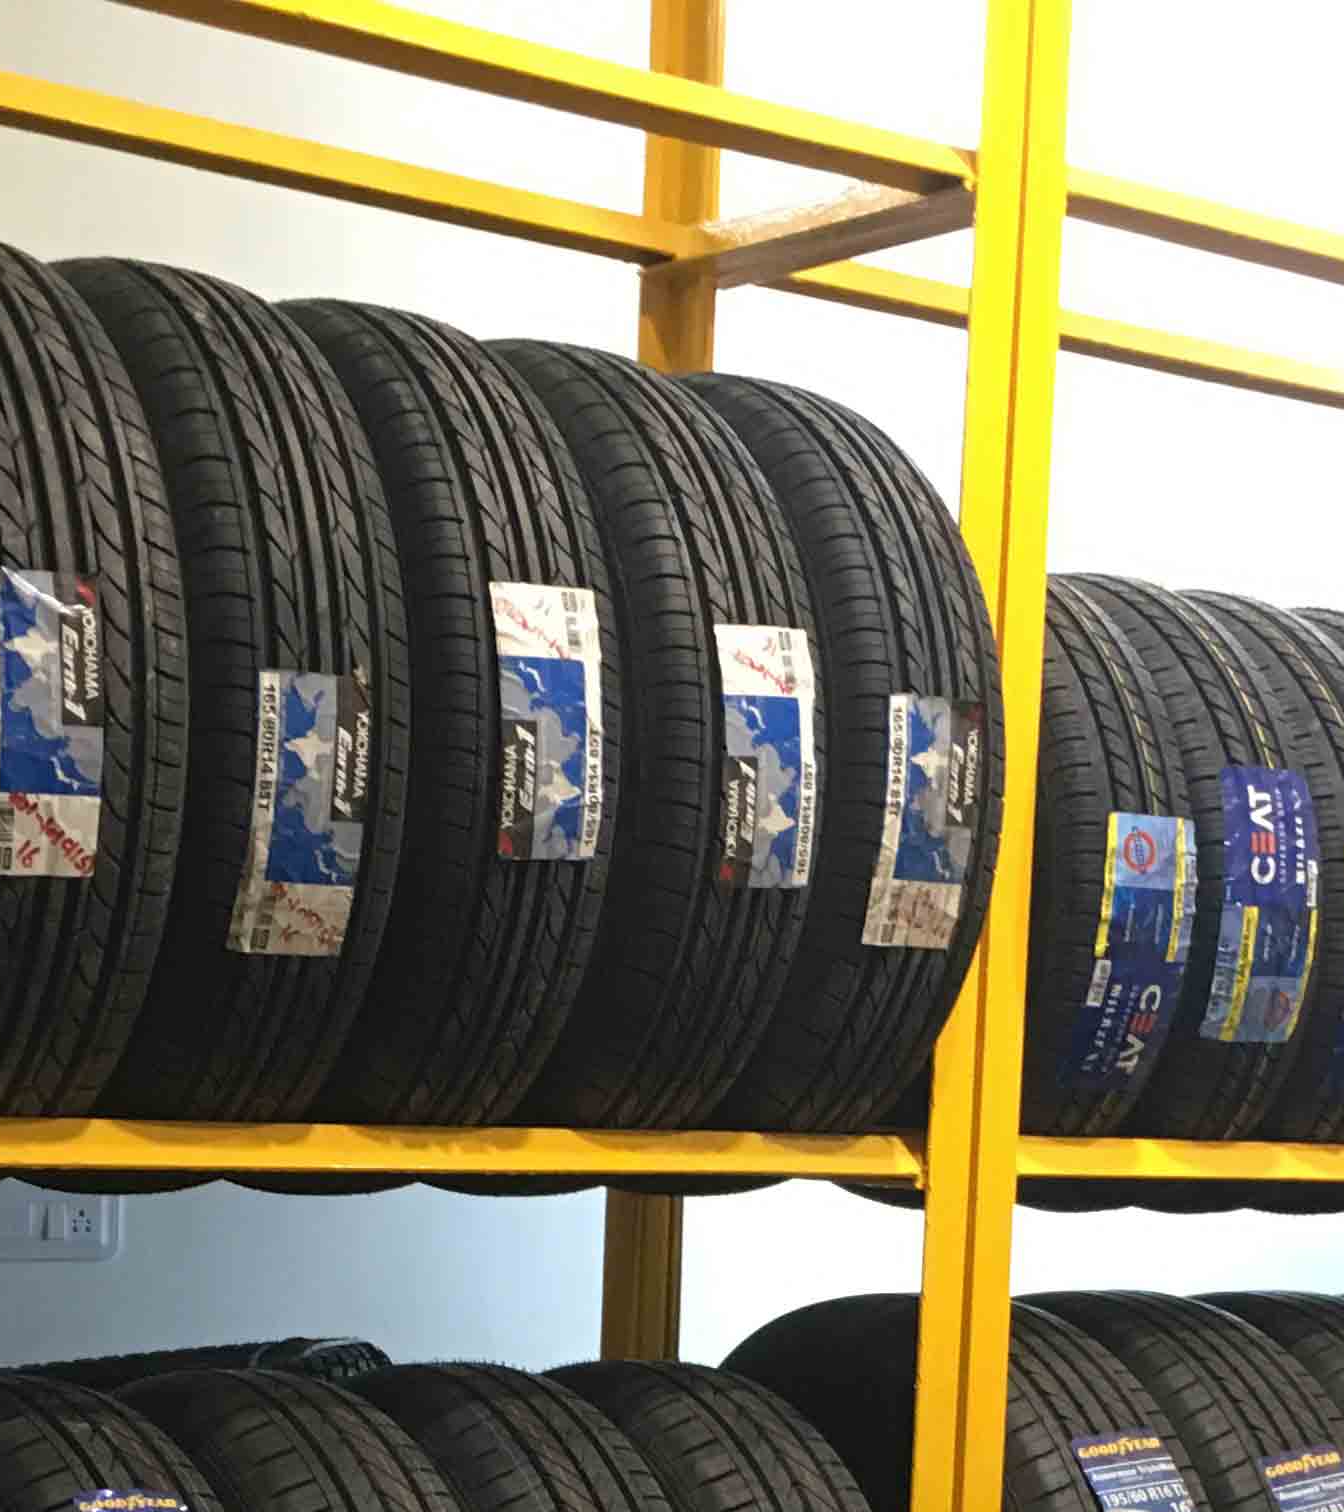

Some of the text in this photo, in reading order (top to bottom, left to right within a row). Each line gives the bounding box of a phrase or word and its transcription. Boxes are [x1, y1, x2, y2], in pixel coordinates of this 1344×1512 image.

[76, 604, 98, 700] YOKOHAMA
[352, 711, 369, 799] YOKOHAMA
[500, 745, 517, 829] YOKOHAMA
[726, 779, 739, 857] YOKOHAMA
[1247, 785, 1276, 885] CEAT
[1116, 984, 1163, 1074] CEAT
[1078, 1437, 1161, 1459] GOODYEAR
[1264, 1451, 1342, 1478] GOODYEAR
[1103, 1489, 1148, 1508] 195/60
[1148, 1486, 1172, 1503] R16
